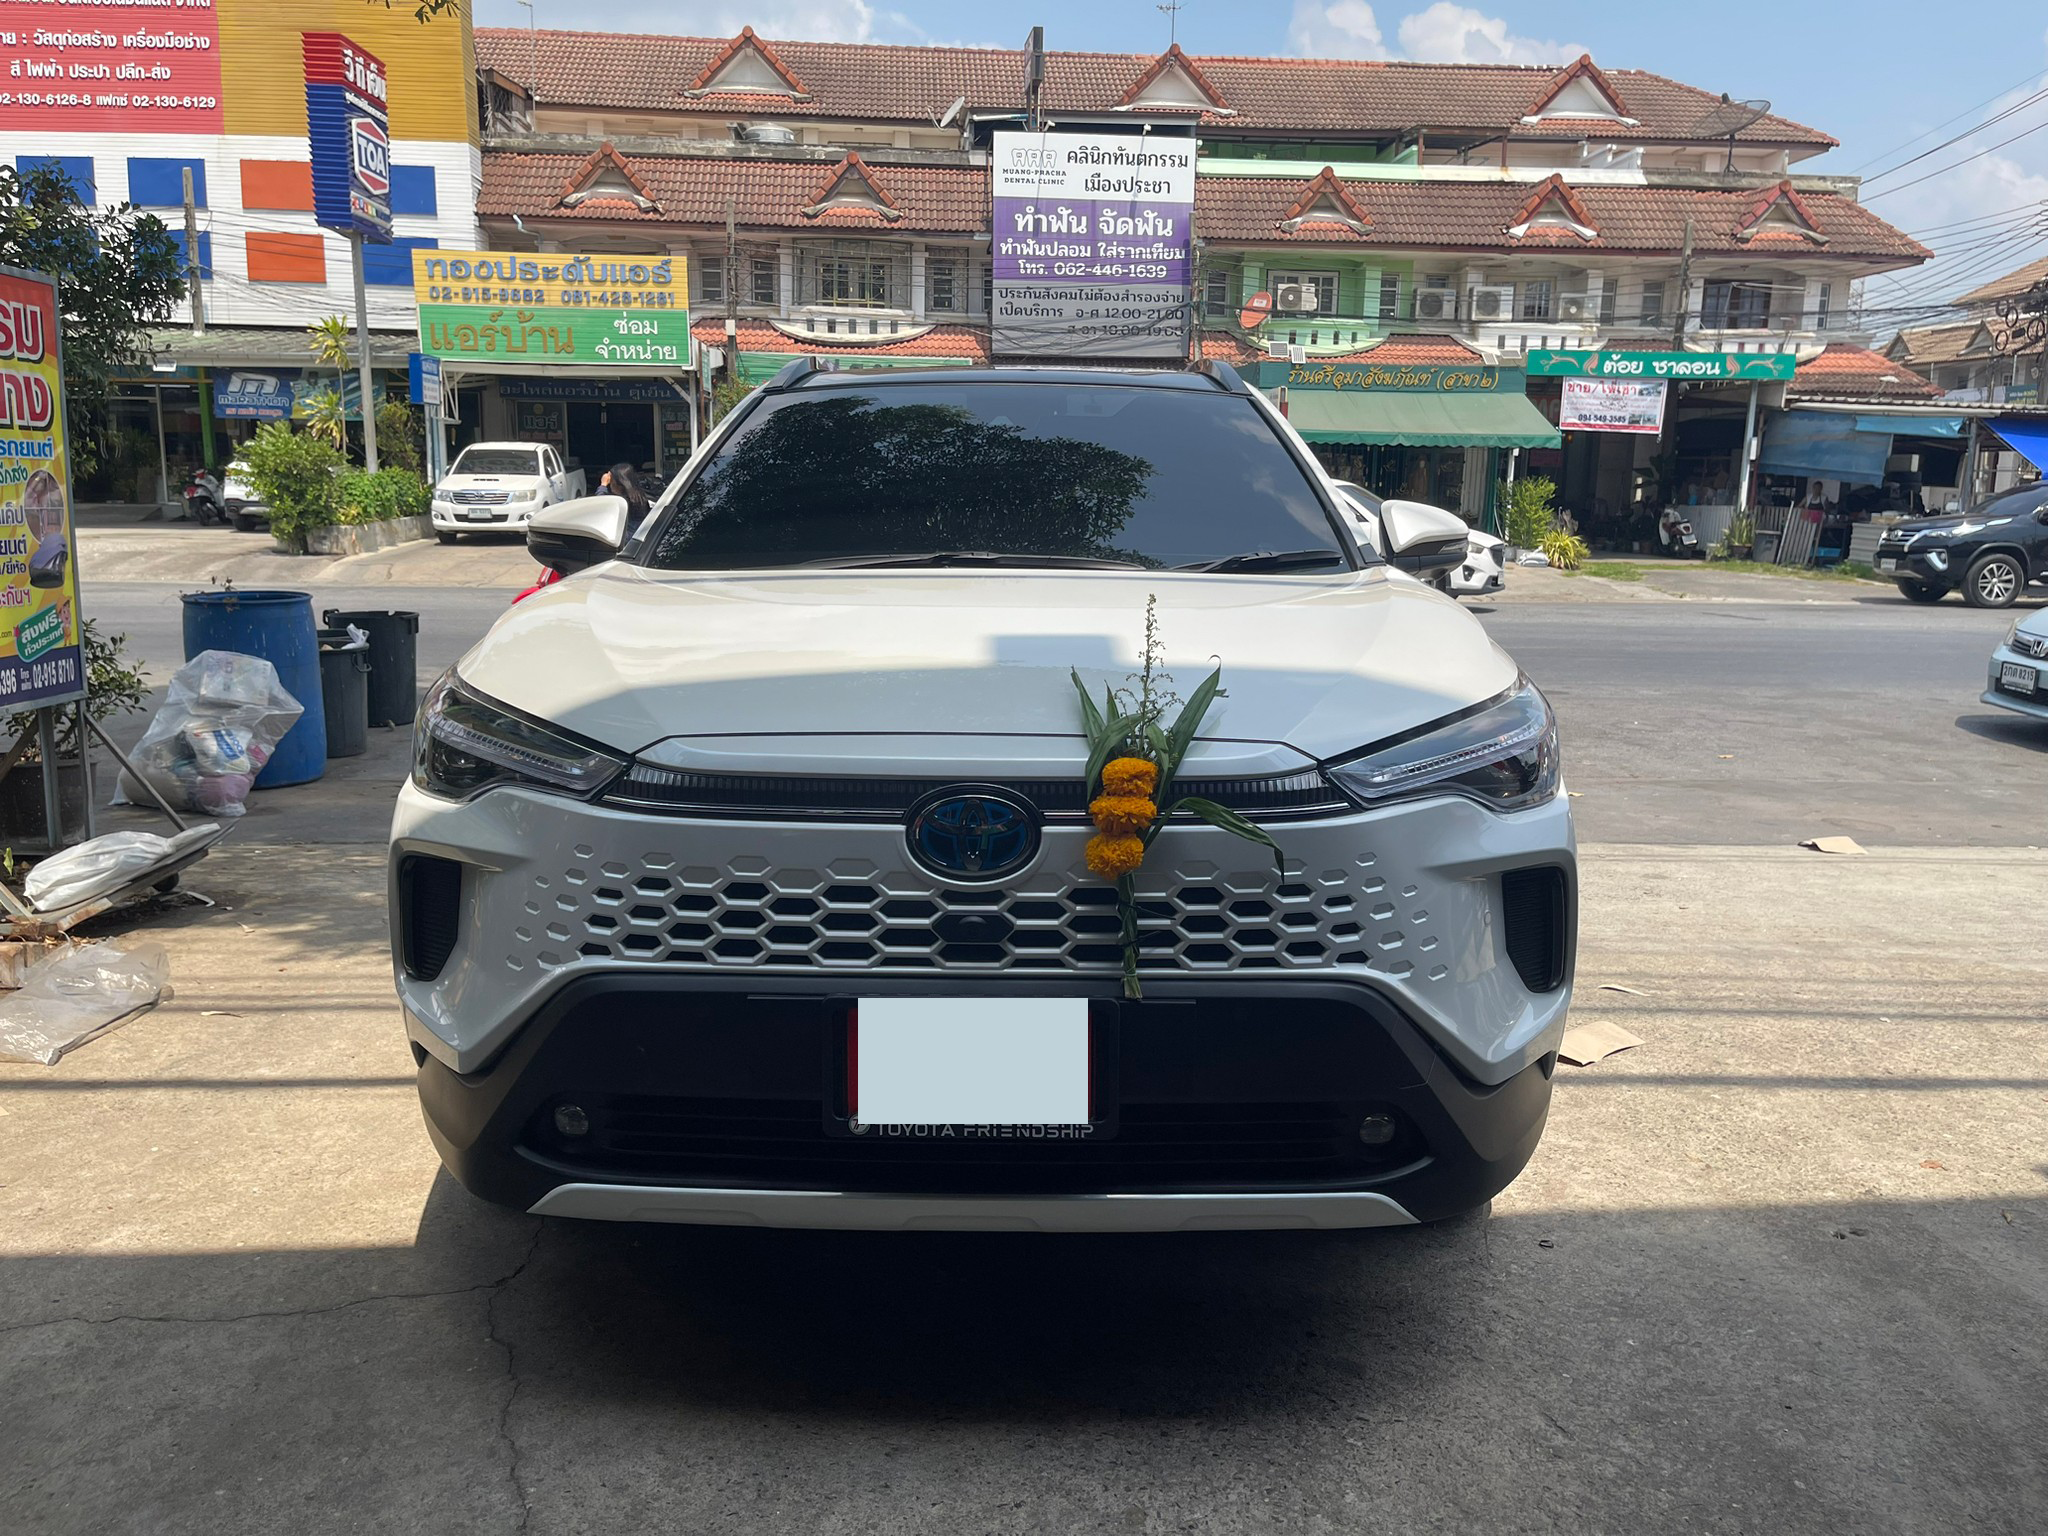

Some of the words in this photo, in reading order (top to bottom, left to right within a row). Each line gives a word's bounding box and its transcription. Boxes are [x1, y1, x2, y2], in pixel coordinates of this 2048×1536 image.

[33, 29, 117, 52] วัสดุก่อสร้าง
[123, 28, 211, 49] เครื่องมือช่าง
[10, 61, 21, 76] สี
[24, 58, 64, 77] ไฟฟ้า
[69, 64, 110, 79] ประปา
[116, 62, 171, 79] ปลีก-ส่ง
[132, 95, 216, 108] 02-130-6129
[357, 136, 386, 177] TOA
[1067, 145, 1189, 169] คลินิกทันตกรรม
[1002, 168, 1067, 177] MUANG-PRACHA
[1004, 177, 1036, 185] DENTAL
[1038, 178, 1065, 186] CLINIC
[1084, 173, 1171, 195] เมืองประชา
[1014, 206, 1088, 235] ทำฟัน
[1099, 208, 1173, 237] จัดฟัน
[1000, 238, 1091, 258] ทำฟันปลอม
[425, 256, 673, 284] ทองประดับแอร์
[1018, 260, 1048, 276] โทร.
[1054, 262, 1168, 278] 062-446-1639
[560, 290, 675, 306] 081-428-1281
[999, 302, 1064, 318] เปิดบริการ
[428, 310, 576, 354] แอร์บ้าน
[612, 312, 659, 336] ซ่อม
[595, 338, 678, 361] จำหน่าย
[1603, 353, 1644, 375] ต้อย
[1652, 361, 1721, 376] ซาลอน
